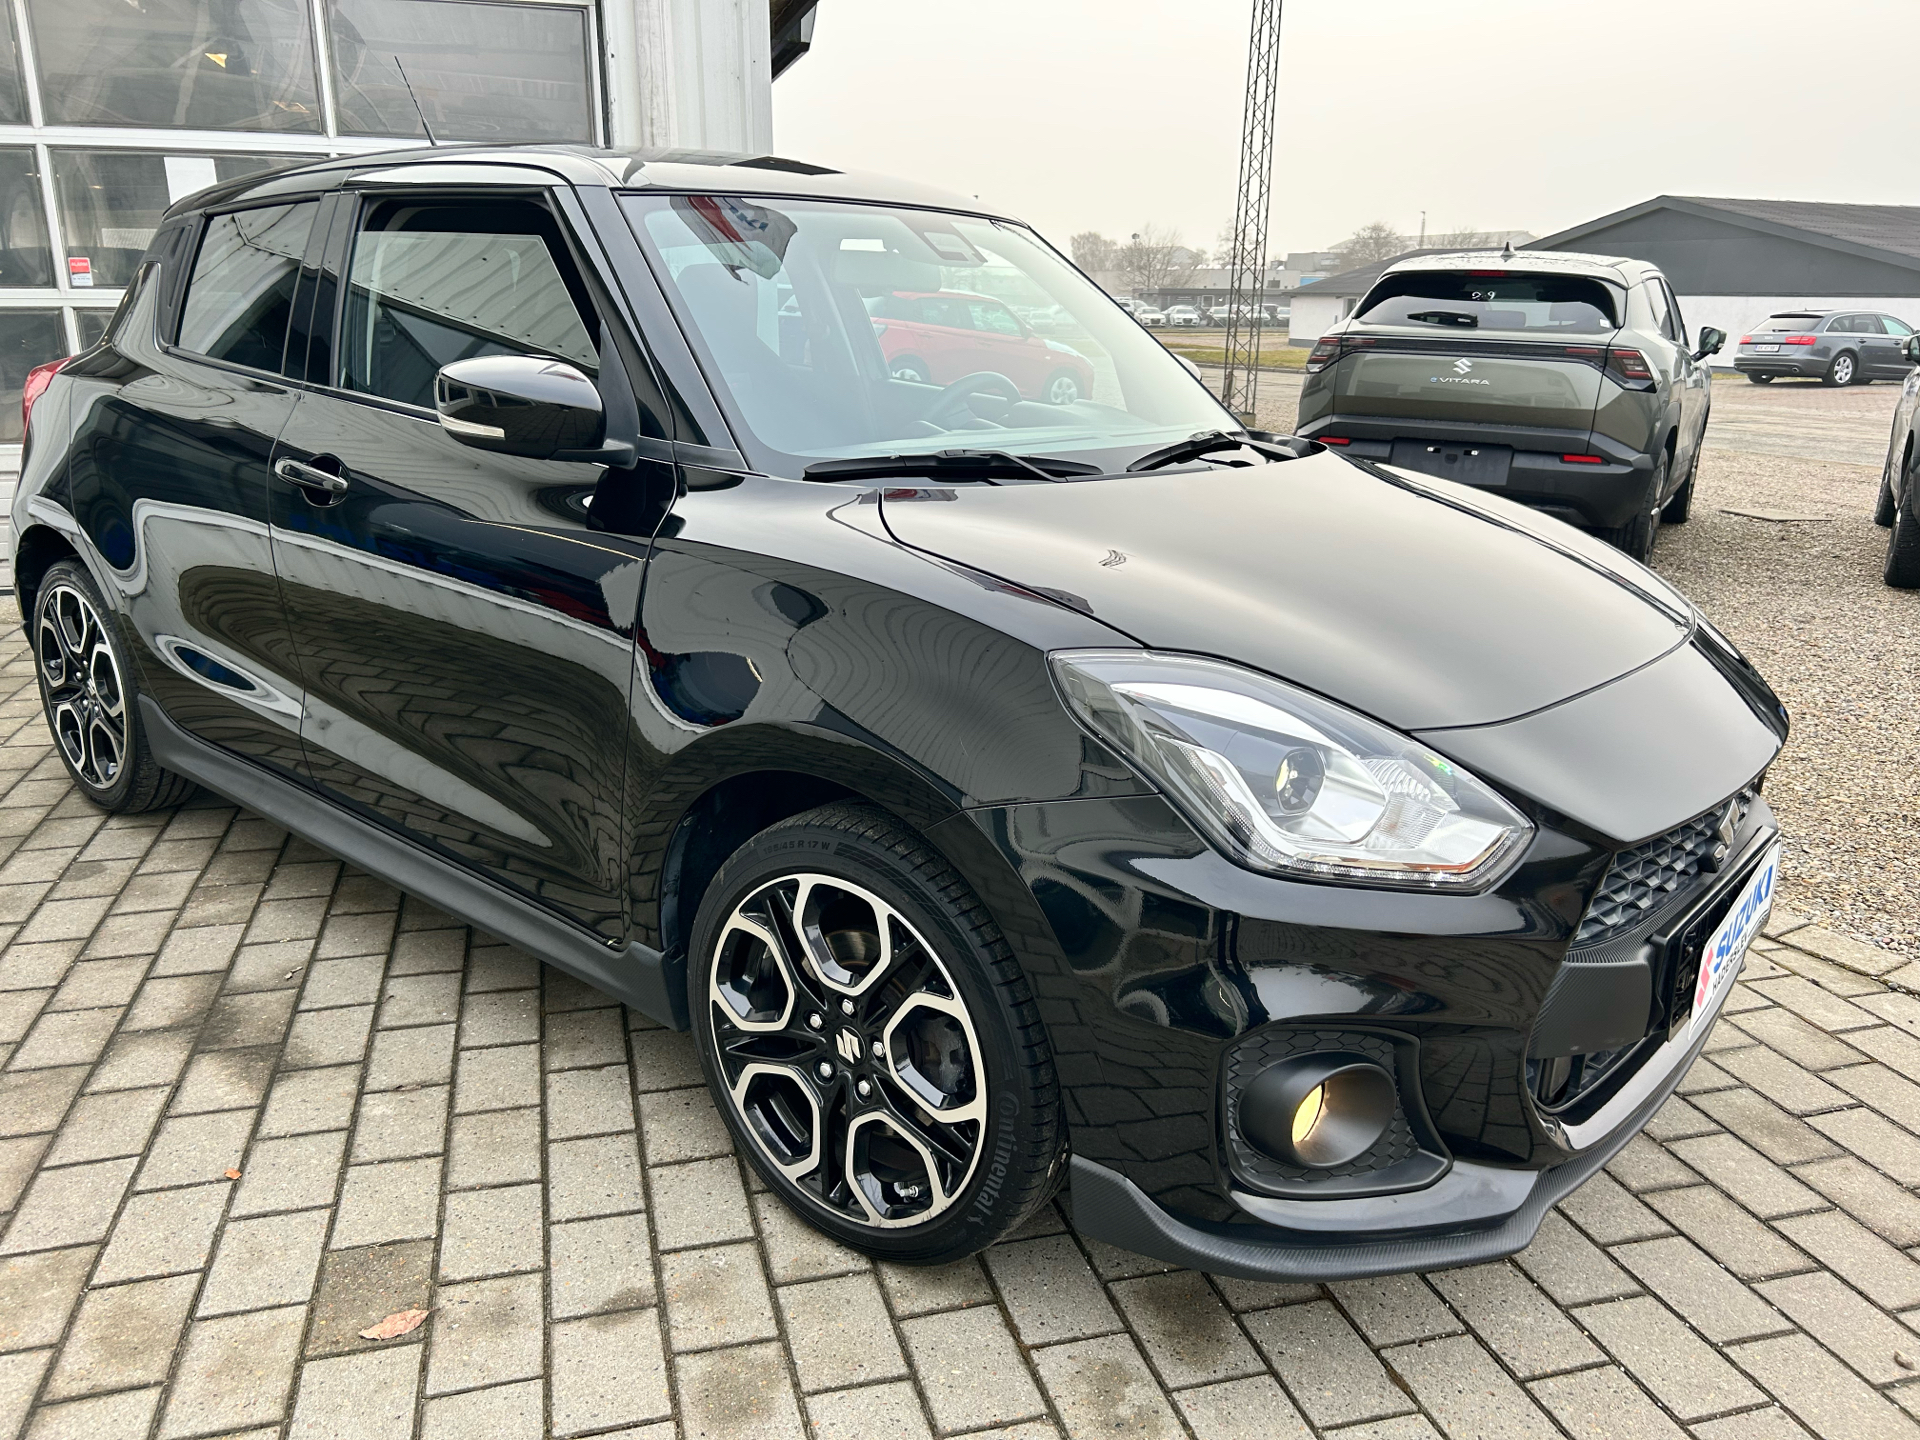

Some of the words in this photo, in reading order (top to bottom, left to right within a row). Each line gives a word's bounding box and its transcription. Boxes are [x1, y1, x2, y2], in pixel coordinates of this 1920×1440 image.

[1439, 377, 1490, 386] VITARA
[763, 840, 795, 855] 195/45
[797, 839, 805, 848] R
[807, 840, 819, 849] 17
[1713, 864, 1773, 974] SUZUKI
[1712, 928, 1749, 995] HADERSLEV
[972, 1090, 1020, 1216] Continental
